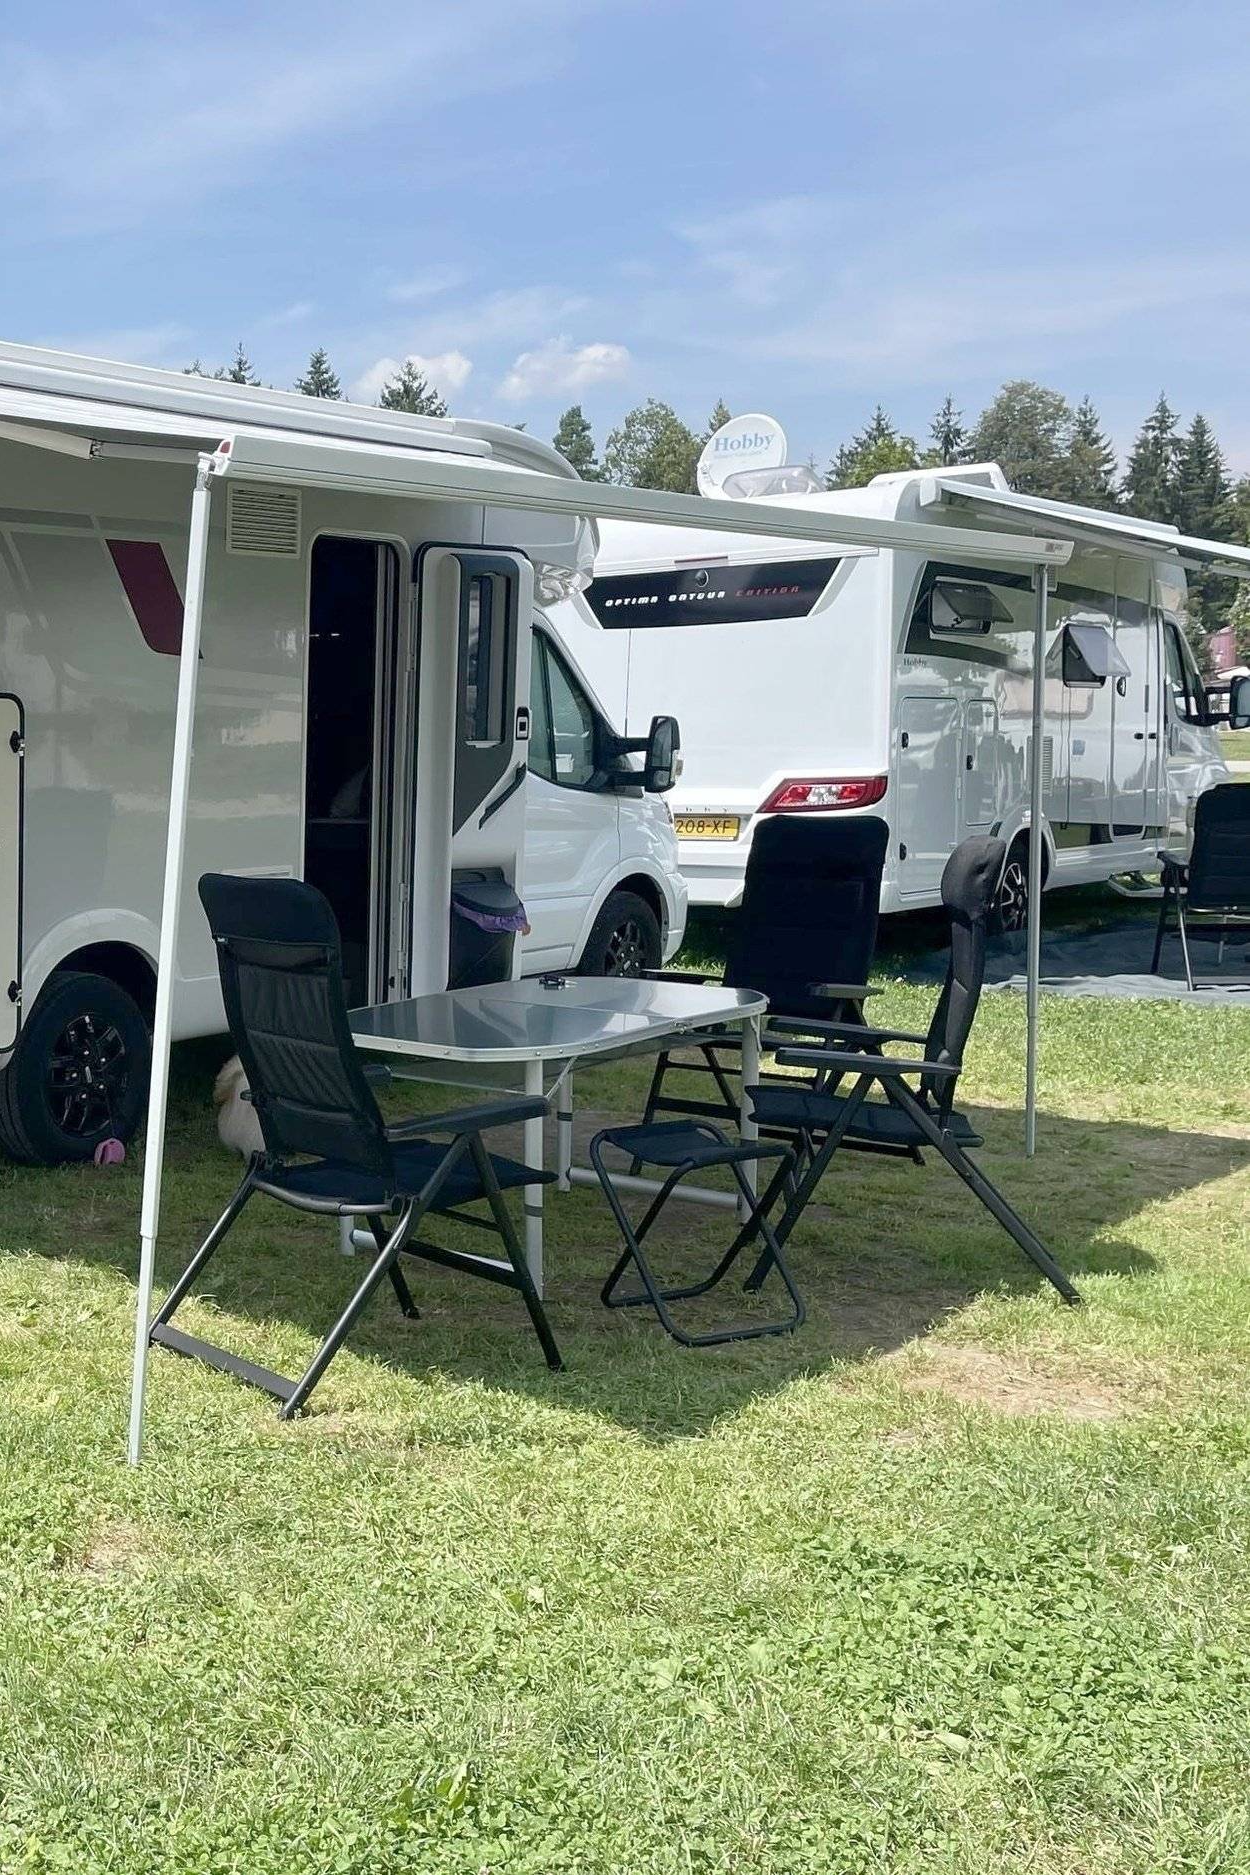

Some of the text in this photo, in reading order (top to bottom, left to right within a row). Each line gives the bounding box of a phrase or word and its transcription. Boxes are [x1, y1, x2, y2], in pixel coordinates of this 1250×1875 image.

[714, 433, 774, 453] Hobby
[605, 595, 659, 607] OPTIMA
[675, 819, 732, 834] 208-XF
